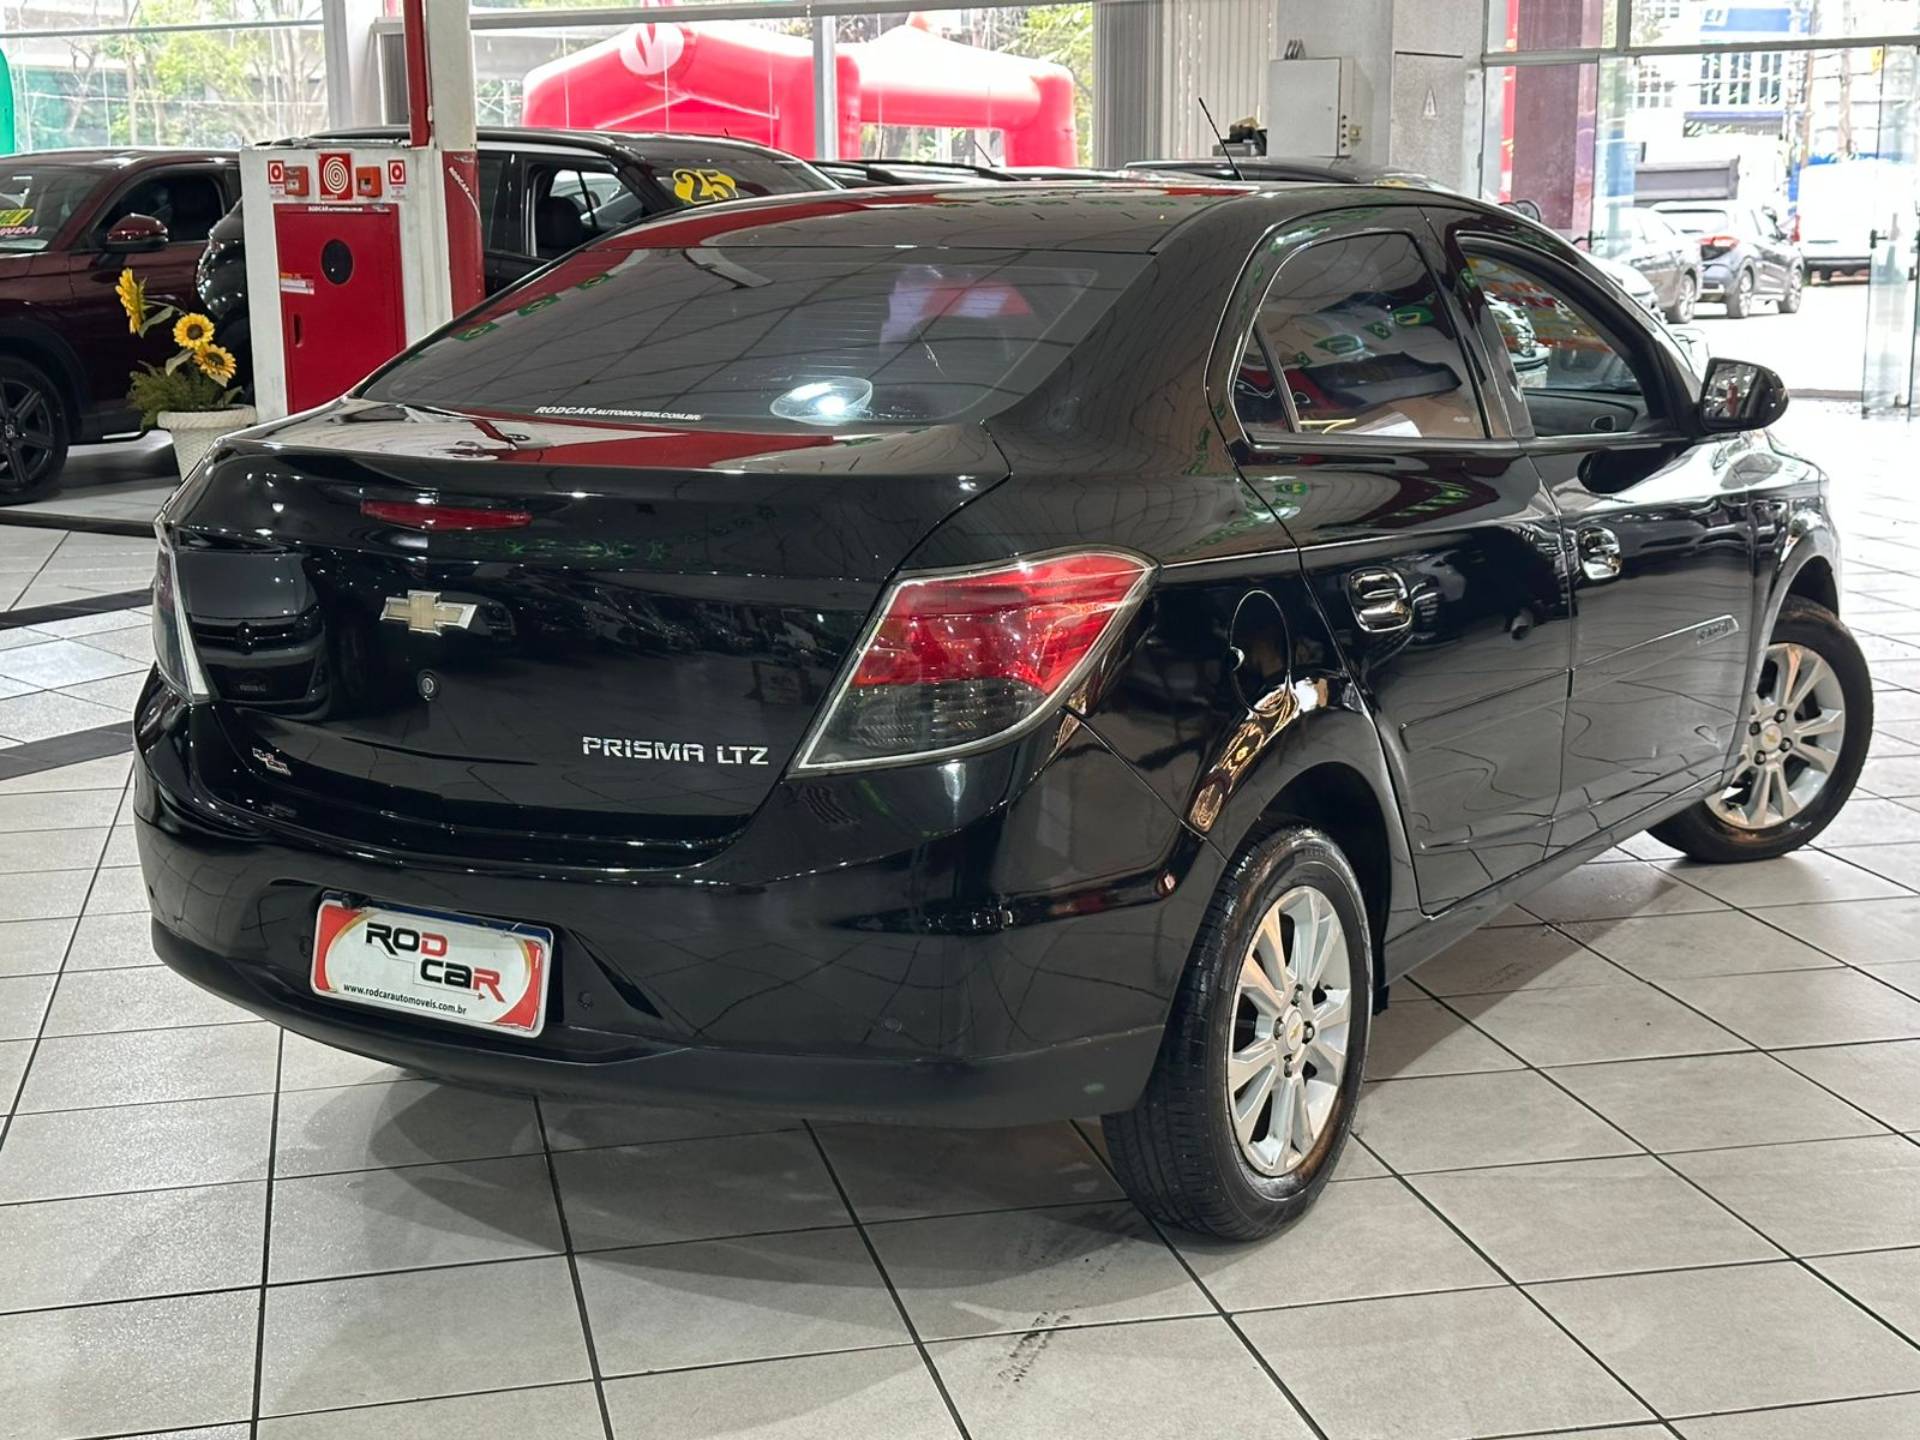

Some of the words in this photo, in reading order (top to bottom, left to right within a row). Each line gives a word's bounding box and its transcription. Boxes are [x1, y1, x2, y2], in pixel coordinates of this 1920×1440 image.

[673, 168, 739, 204] 25
[582, 736, 705, 763] PRISMA
[716, 745, 769, 765] LTZ
[343, 983, 467, 1015] www.rodcarautomoveis.com.br
